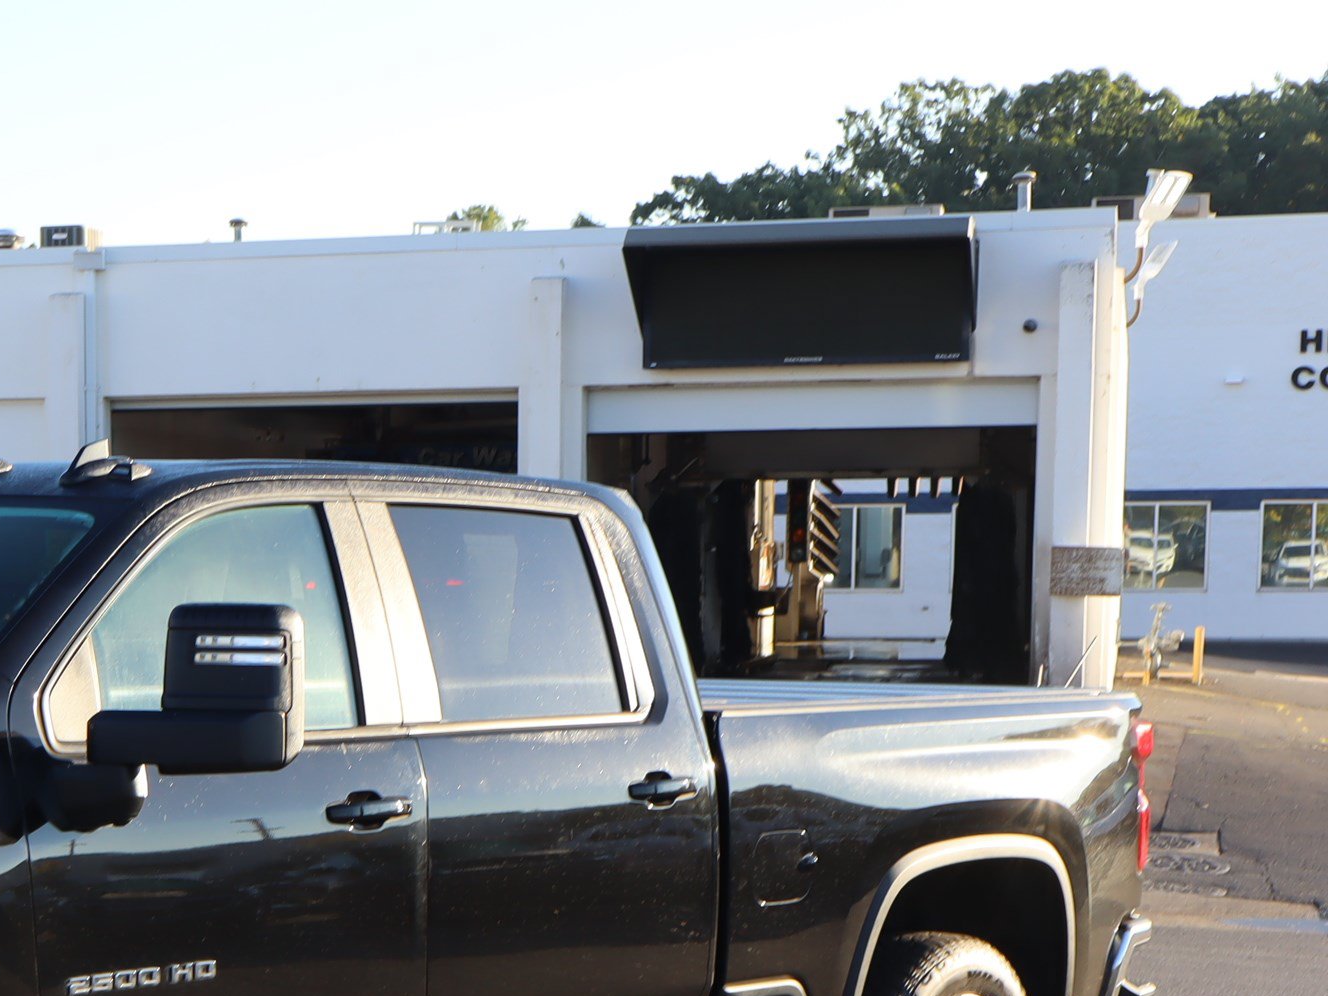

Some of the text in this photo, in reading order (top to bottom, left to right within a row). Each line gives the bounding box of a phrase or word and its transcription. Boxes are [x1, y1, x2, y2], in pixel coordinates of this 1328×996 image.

[1300, 329, 1328, 353] H
[66, 959, 217, 996] 2500 HD
